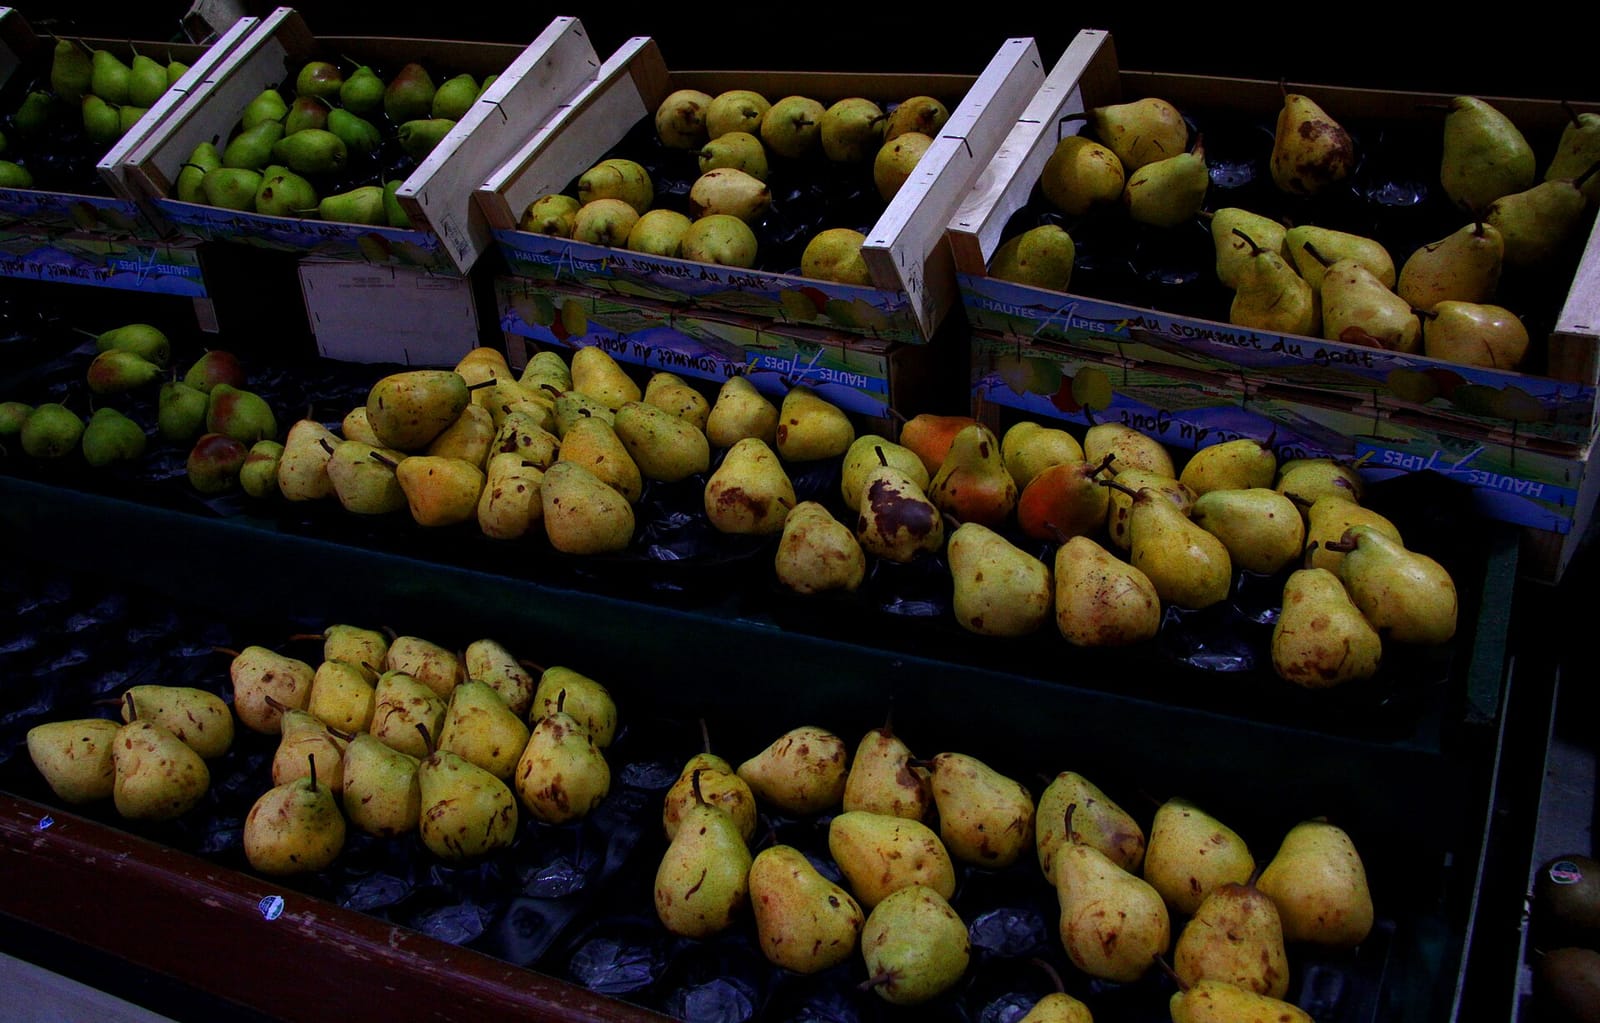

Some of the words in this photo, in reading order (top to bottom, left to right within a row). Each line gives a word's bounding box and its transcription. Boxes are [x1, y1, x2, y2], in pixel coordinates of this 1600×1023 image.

[156, 263, 189, 276] HAUTES
[513, 250, 552, 265] HAUTES
[549, 244, 598, 281] ALPES
[631, 258, 695, 279] sommet
[699, 265, 722, 283] du
[981, 299, 1036, 318] HAUTES
[1031, 300, 1106, 336] ALPES
[632, 343, 653, 364] du
[1170, 322, 1262, 350] sommet
[1271, 336, 1303, 358] du
[1313, 348, 1374, 369] goût
[657, 349, 717, 374] sommet
[818, 369, 868, 388] HAUTES
[1179, 422, 1209, 450] du
[1468, 469, 1546, 498] HAUTES
